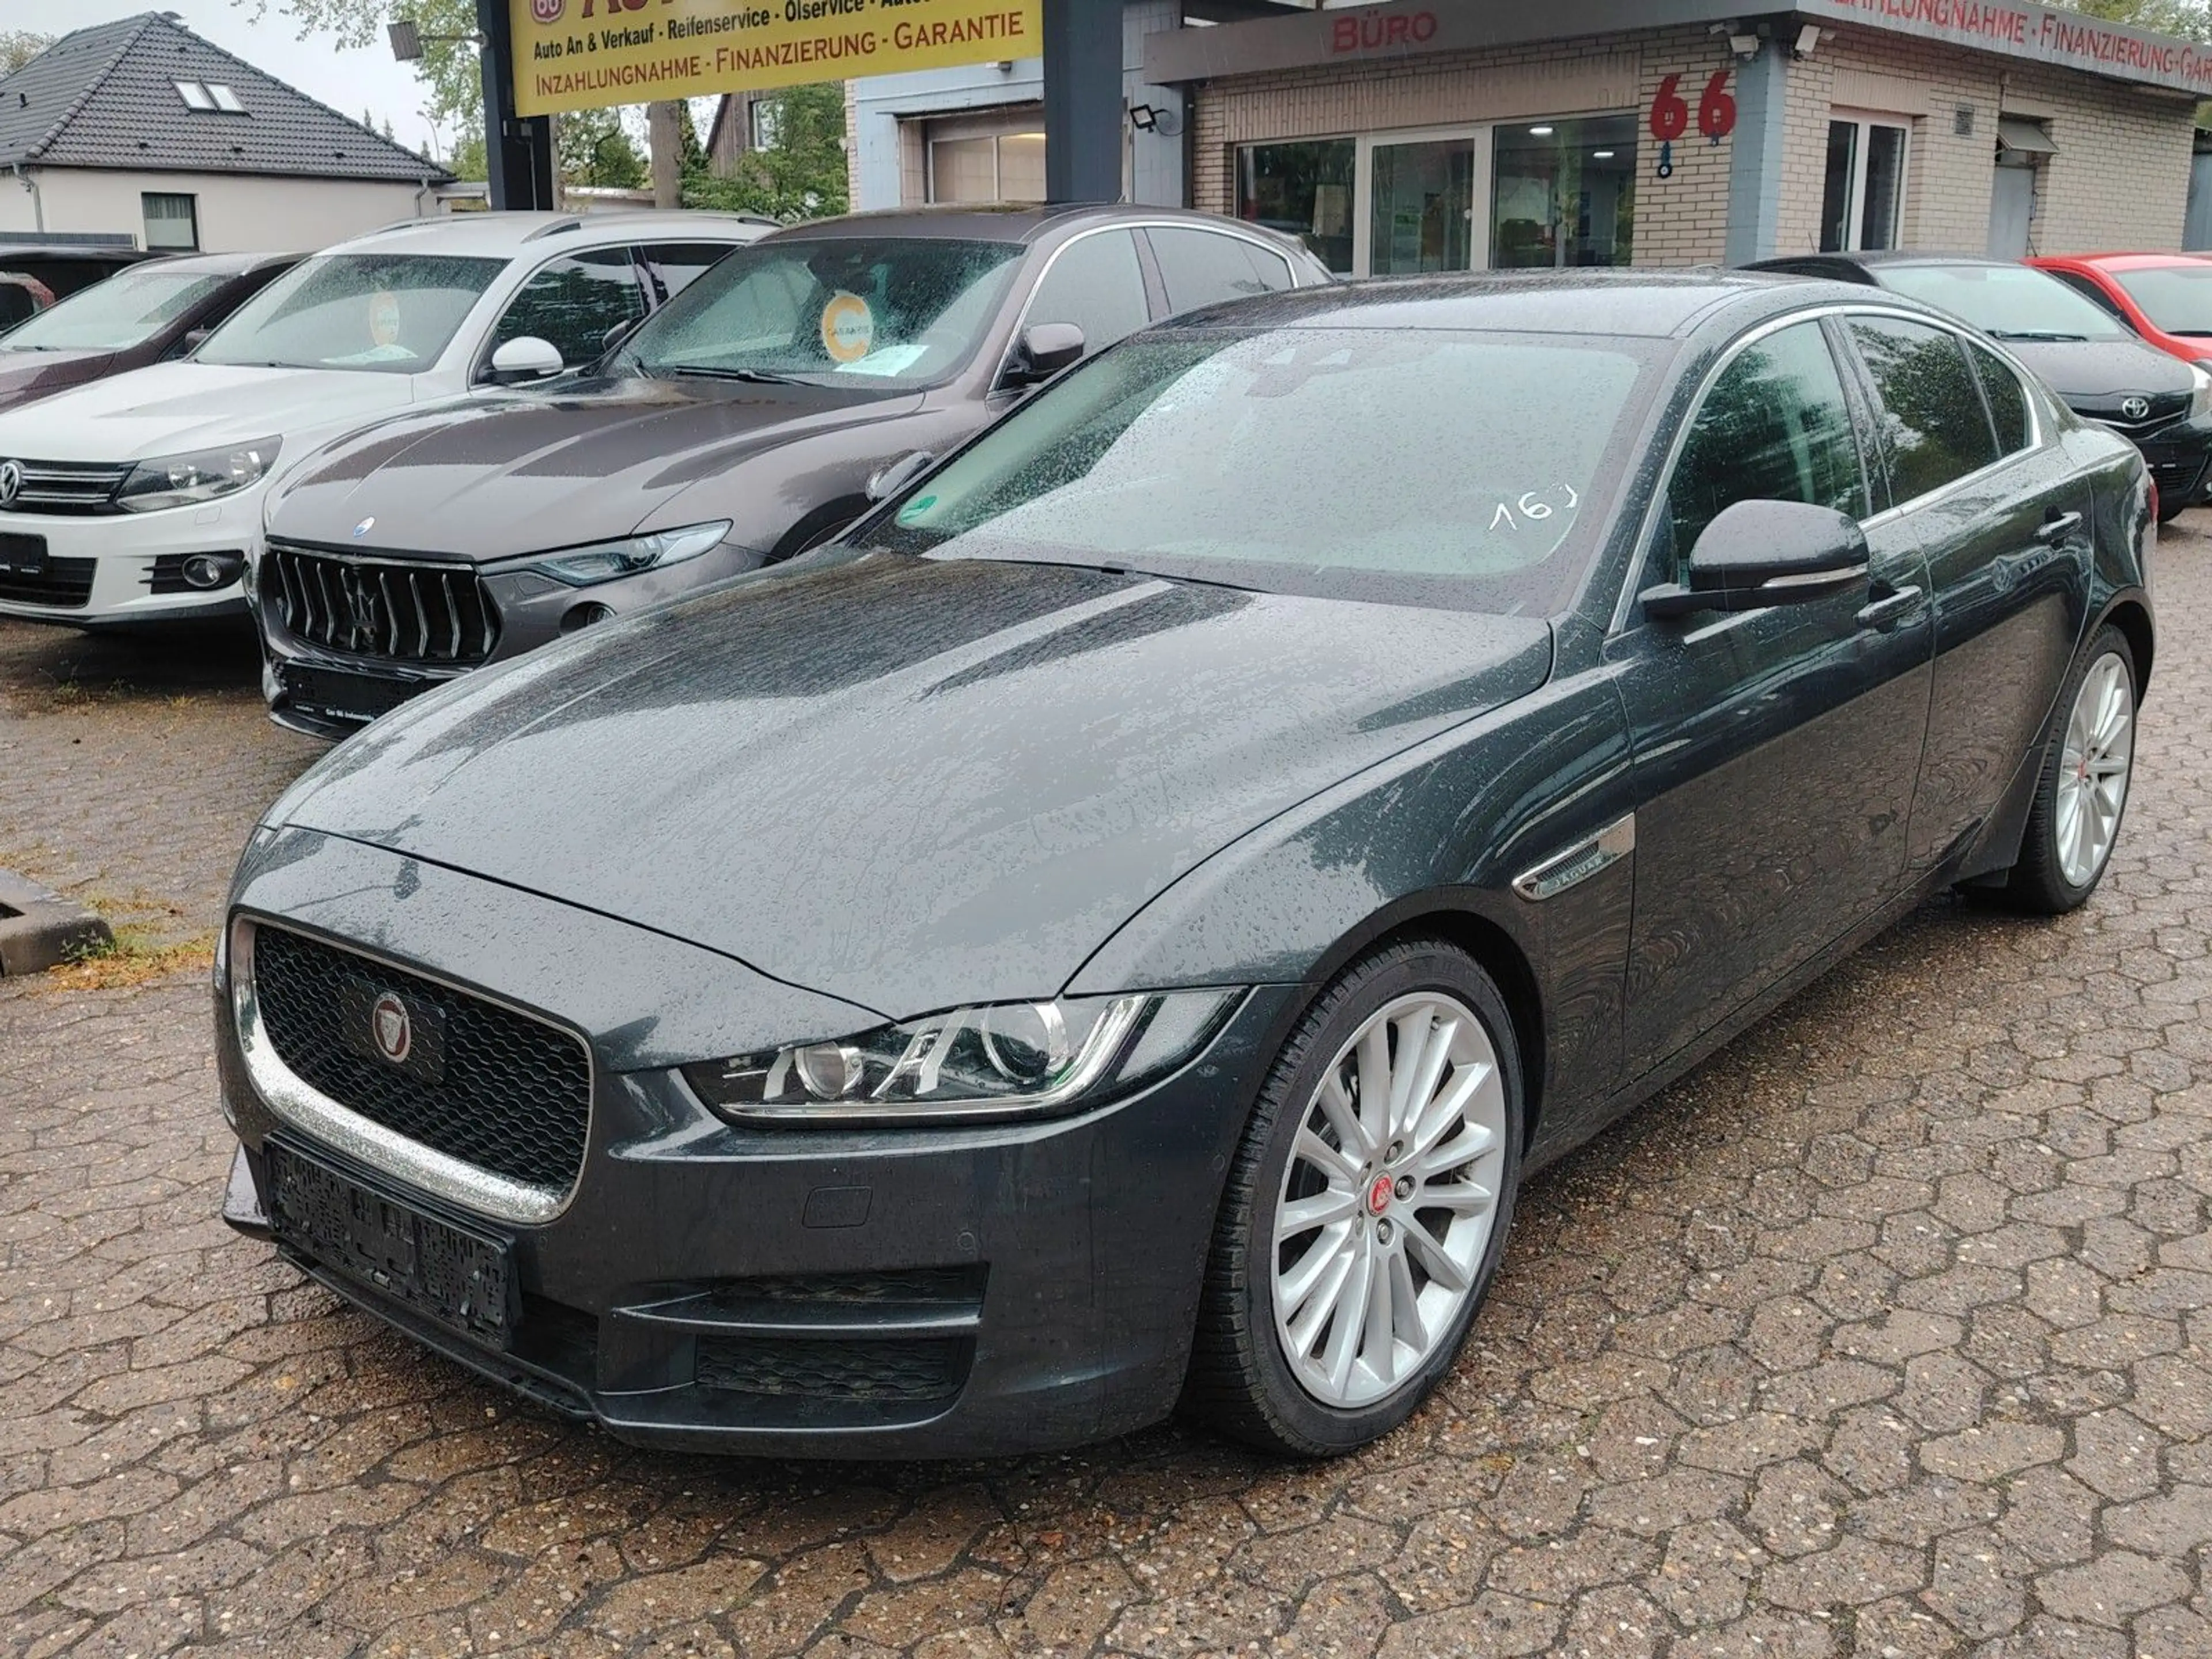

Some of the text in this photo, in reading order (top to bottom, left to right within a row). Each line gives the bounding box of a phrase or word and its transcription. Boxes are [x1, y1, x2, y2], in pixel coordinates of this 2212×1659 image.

[534, 41, 562, 60] Auto
[567, 36, 582, 56] An
[588, 32, 596, 52] &
[601, 23, 655, 50] Verkauf
[668, 7, 770, 39] Reifenservice
[536, 11, 1024, 96] INZAHLUNGNAHME FINANZIERUNG GARANTIE
[1333, 10, 1438, 53] BÜRO
[1650, 69, 1737, 141] 66
[1555, 855, 1603, 888] JAGUAR
